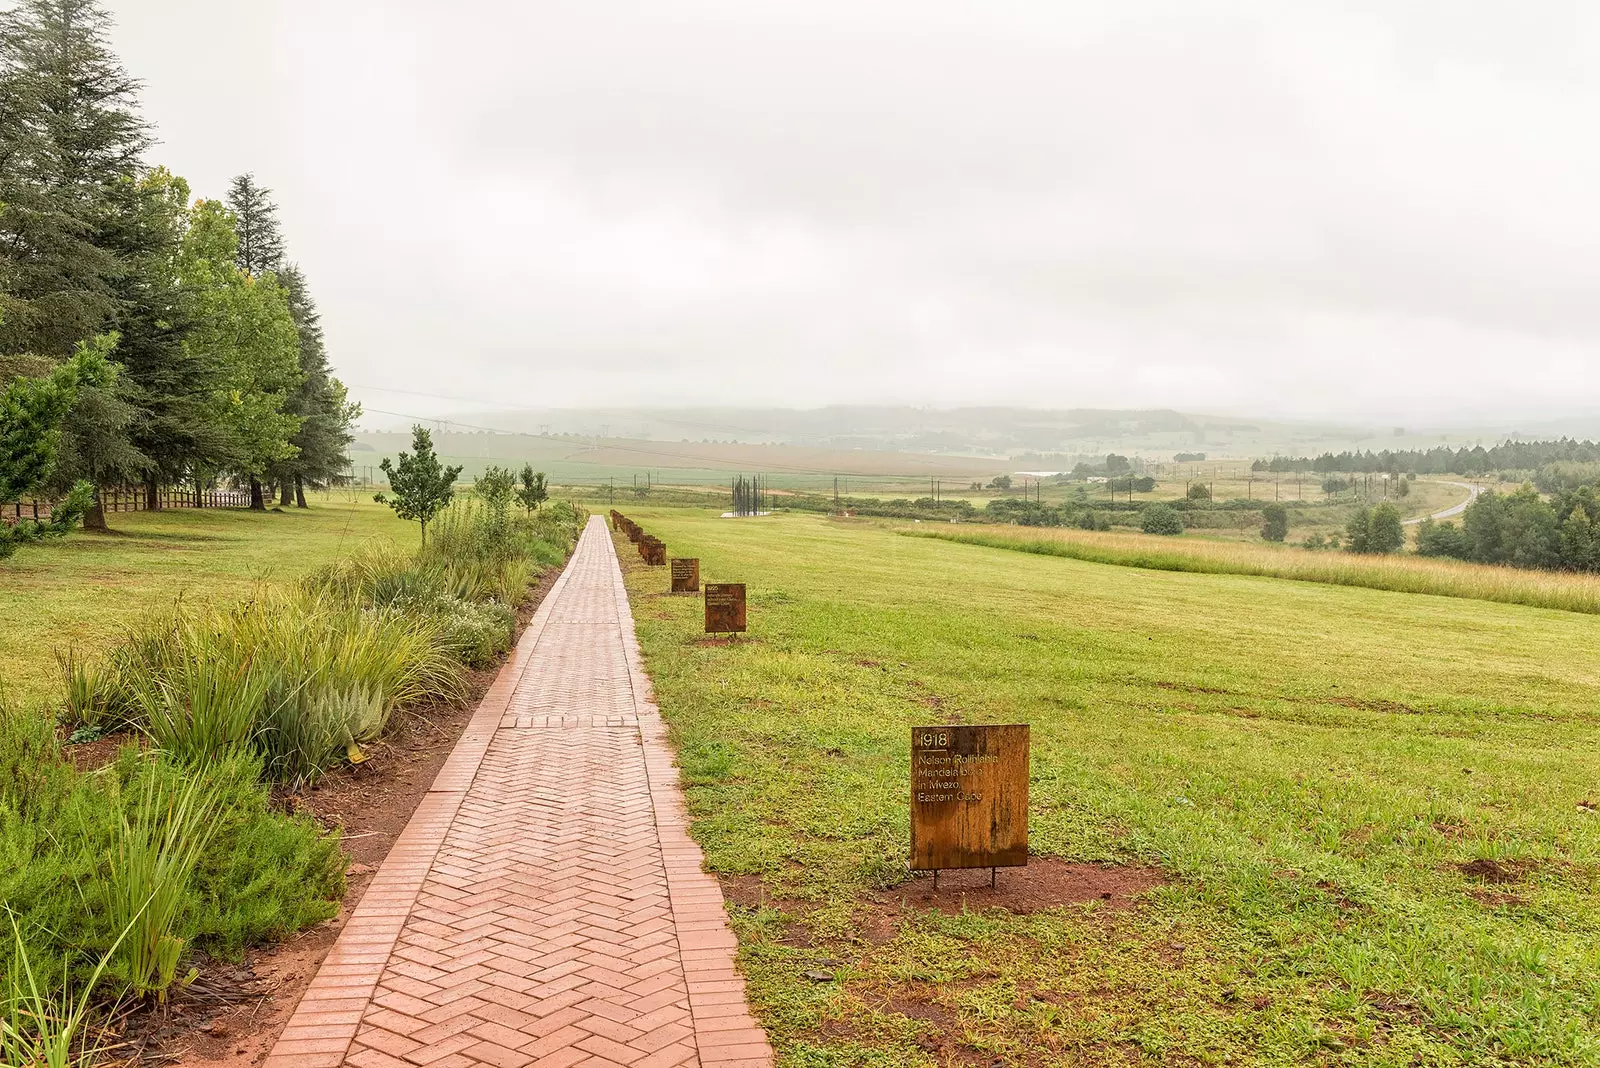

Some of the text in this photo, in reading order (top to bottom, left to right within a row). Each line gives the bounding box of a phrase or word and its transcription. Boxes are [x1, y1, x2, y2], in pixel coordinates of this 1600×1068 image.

[920, 733, 947, 747] 1918
[918, 755, 951, 765] Nelson
[918, 767, 958, 777] Mandela
[918, 792, 953, 802] Eastern
